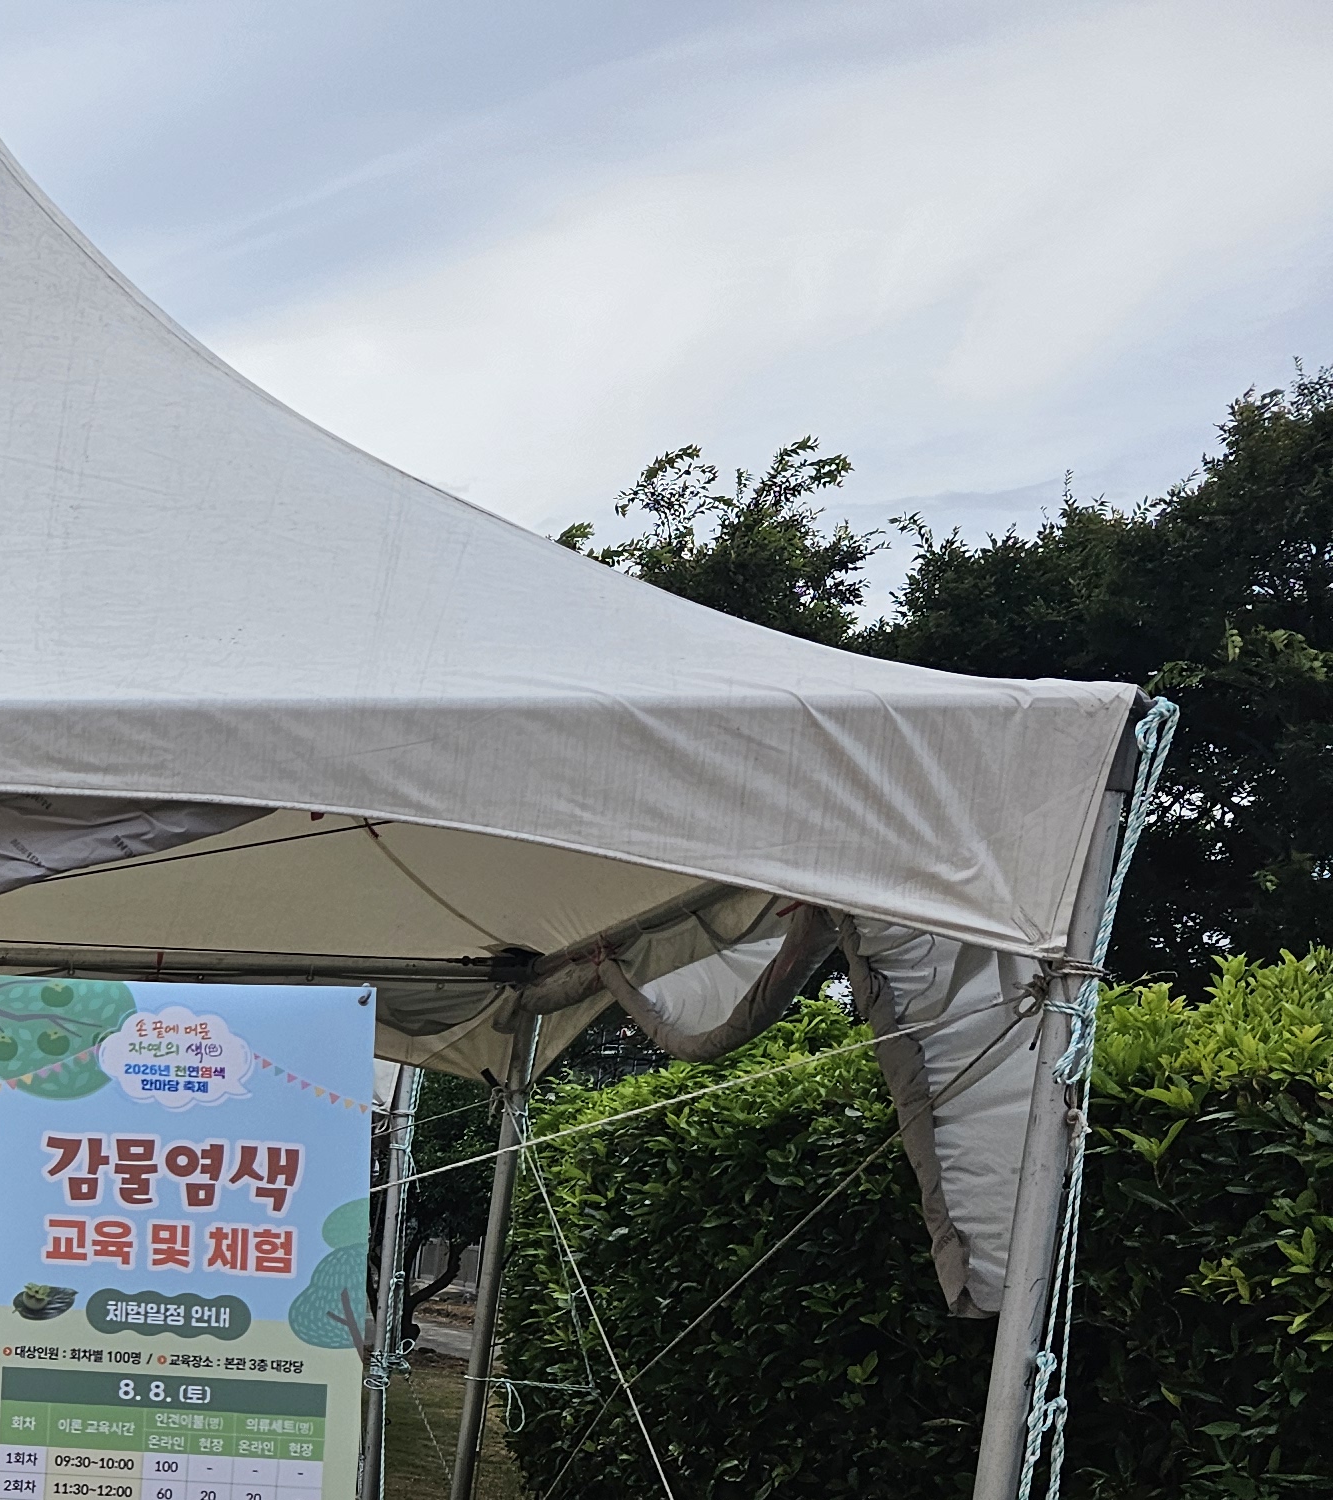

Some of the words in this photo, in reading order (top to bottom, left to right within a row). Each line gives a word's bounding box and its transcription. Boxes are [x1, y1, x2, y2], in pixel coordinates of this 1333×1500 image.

[124, 1064, 170, 1076] 2026년
[175, 1065, 225, 1078] 천연염색
[141, 1079, 180, 1092] 한마당
[183, 1080, 208, 1093] 축제
[45, 1136, 300, 1213] 감물염색
[45, 1219, 134, 1266] 교육
[152, 1224, 191, 1268] 및
[207, 1226, 294, 1275] 체험
[106, 1300, 185, 1326] 체험일정
[191, 1305, 230, 1328] 안내
[14, 1346, 59, 1361] 대상인원
[70, 1348, 103, 1364] 회차별
[107, 1350, 142, 1365] 100명
[169, 1353, 214, 1368] 교육장소
[224, 1356, 246, 1371] 본관
[249, 1358, 268, 1372] 3층
[271, 1359, 304, 1374] 대강당
[5, 1452, 38, 1467] 1회차
[54, 1455, 135, 1471] 09:30~10:00
[154, 1460, 179, 1473] 100
[4, 1479, 36, 1494] 2회차
[52, 1482, 133, 1498] 11:30~12:00
[156, 1488, 173, 1500] 60
